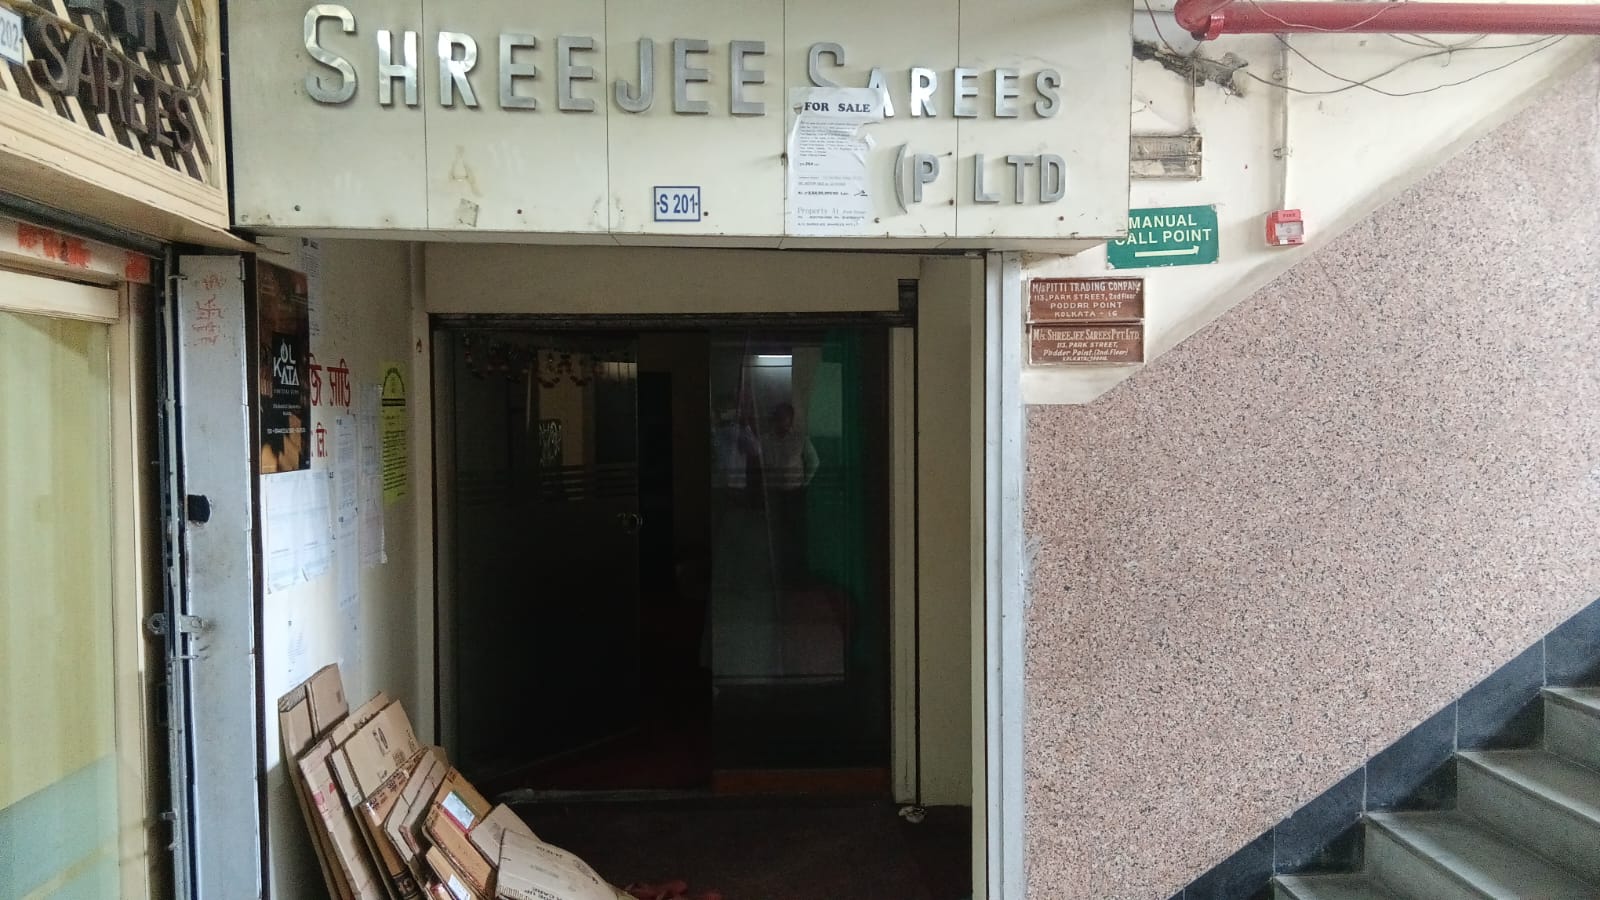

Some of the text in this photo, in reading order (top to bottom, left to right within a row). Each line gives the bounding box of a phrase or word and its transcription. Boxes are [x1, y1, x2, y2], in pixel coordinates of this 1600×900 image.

[303, 4, 766, 116] SHREEJEE
[804, 102, 871, 113] FOR SALE
[974, 154, 1066, 203] LTD
[660, 193, 695, 214] S 201
[1129, 213, 1198, 229] MANUAL
[1163, 228, 1213, 243] POINT
[1046, 282, 1067, 292] PITTI
[1070, 281, 1105, 292] TRADING
[1054, 310, 1096, 318] KOLKATA
